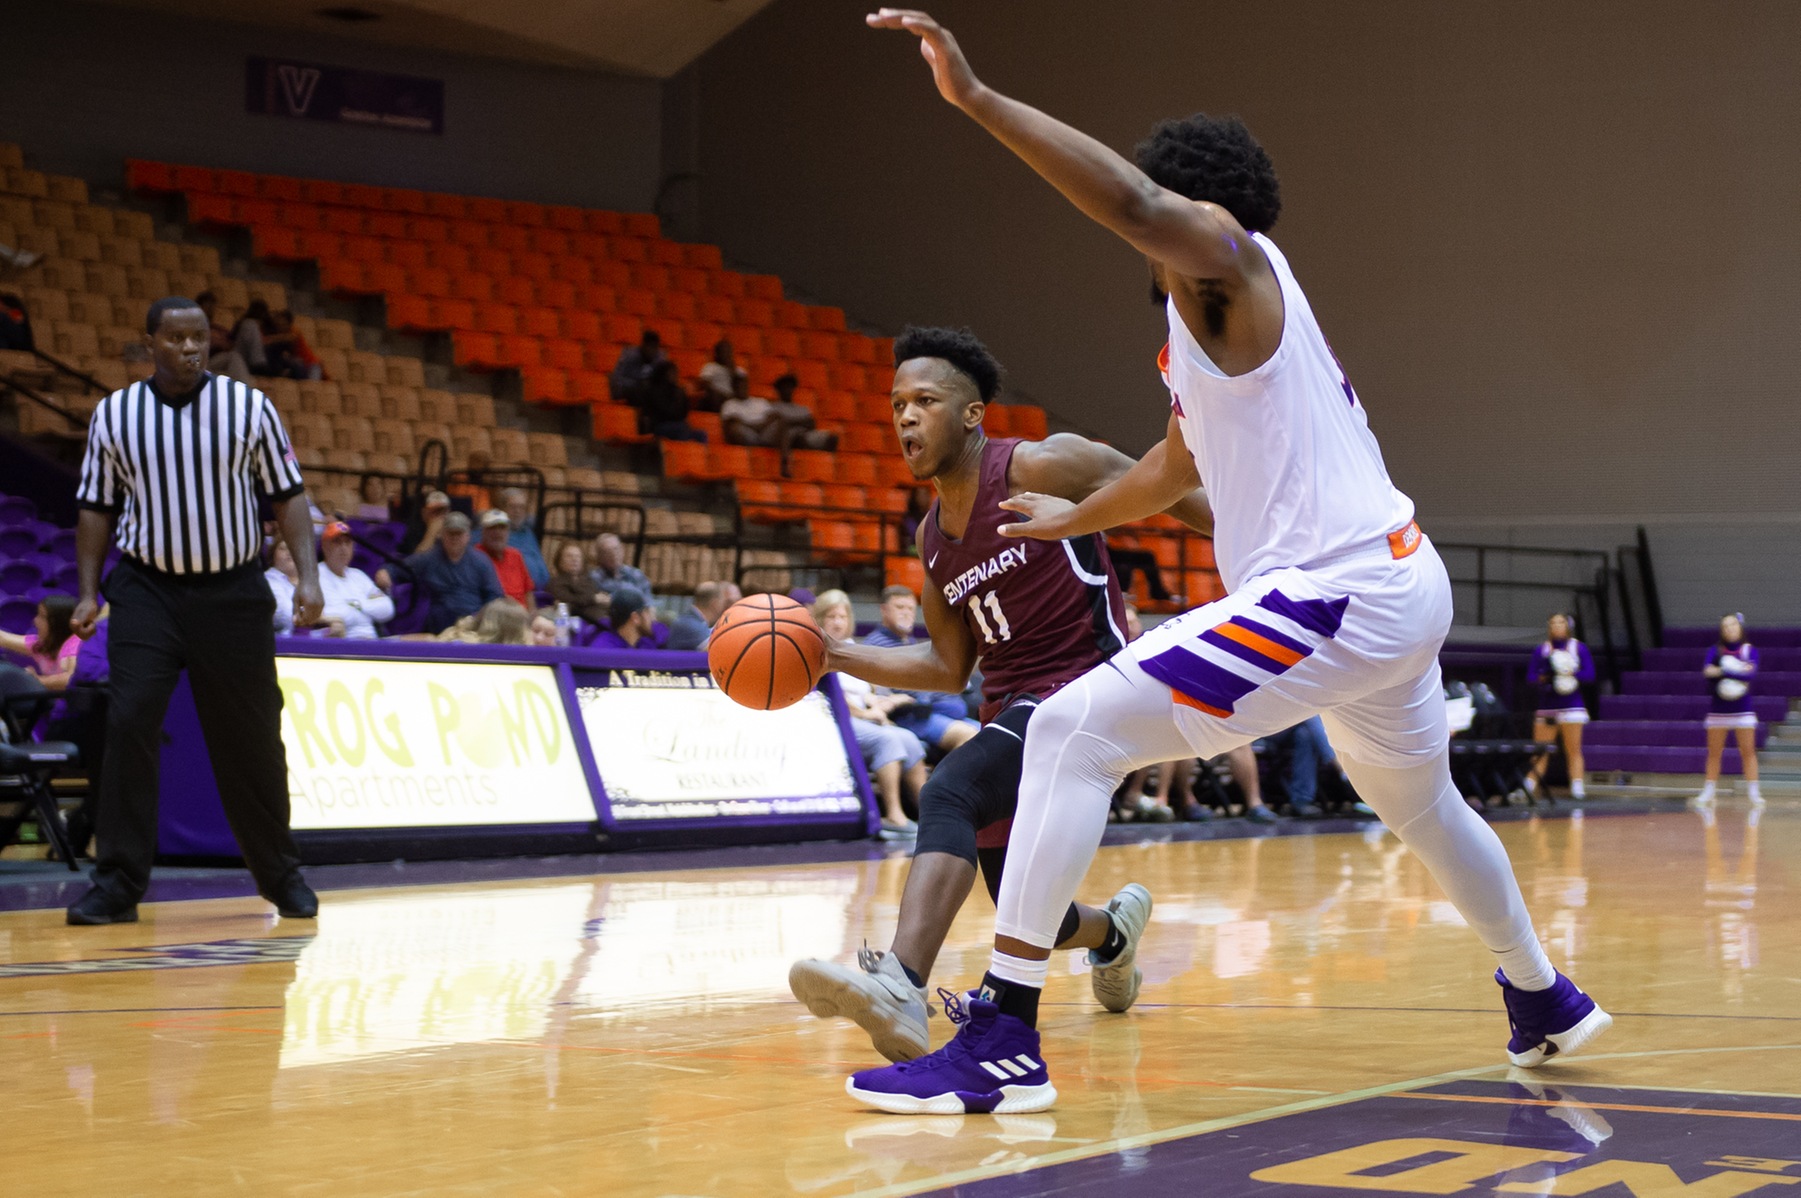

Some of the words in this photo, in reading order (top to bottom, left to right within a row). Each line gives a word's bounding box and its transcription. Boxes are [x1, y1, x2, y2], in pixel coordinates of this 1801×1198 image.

[943, 543, 1027, 605] ENTENARY
[968, 589, 1011, 644] 11
[278, 676, 415, 768] ROG
